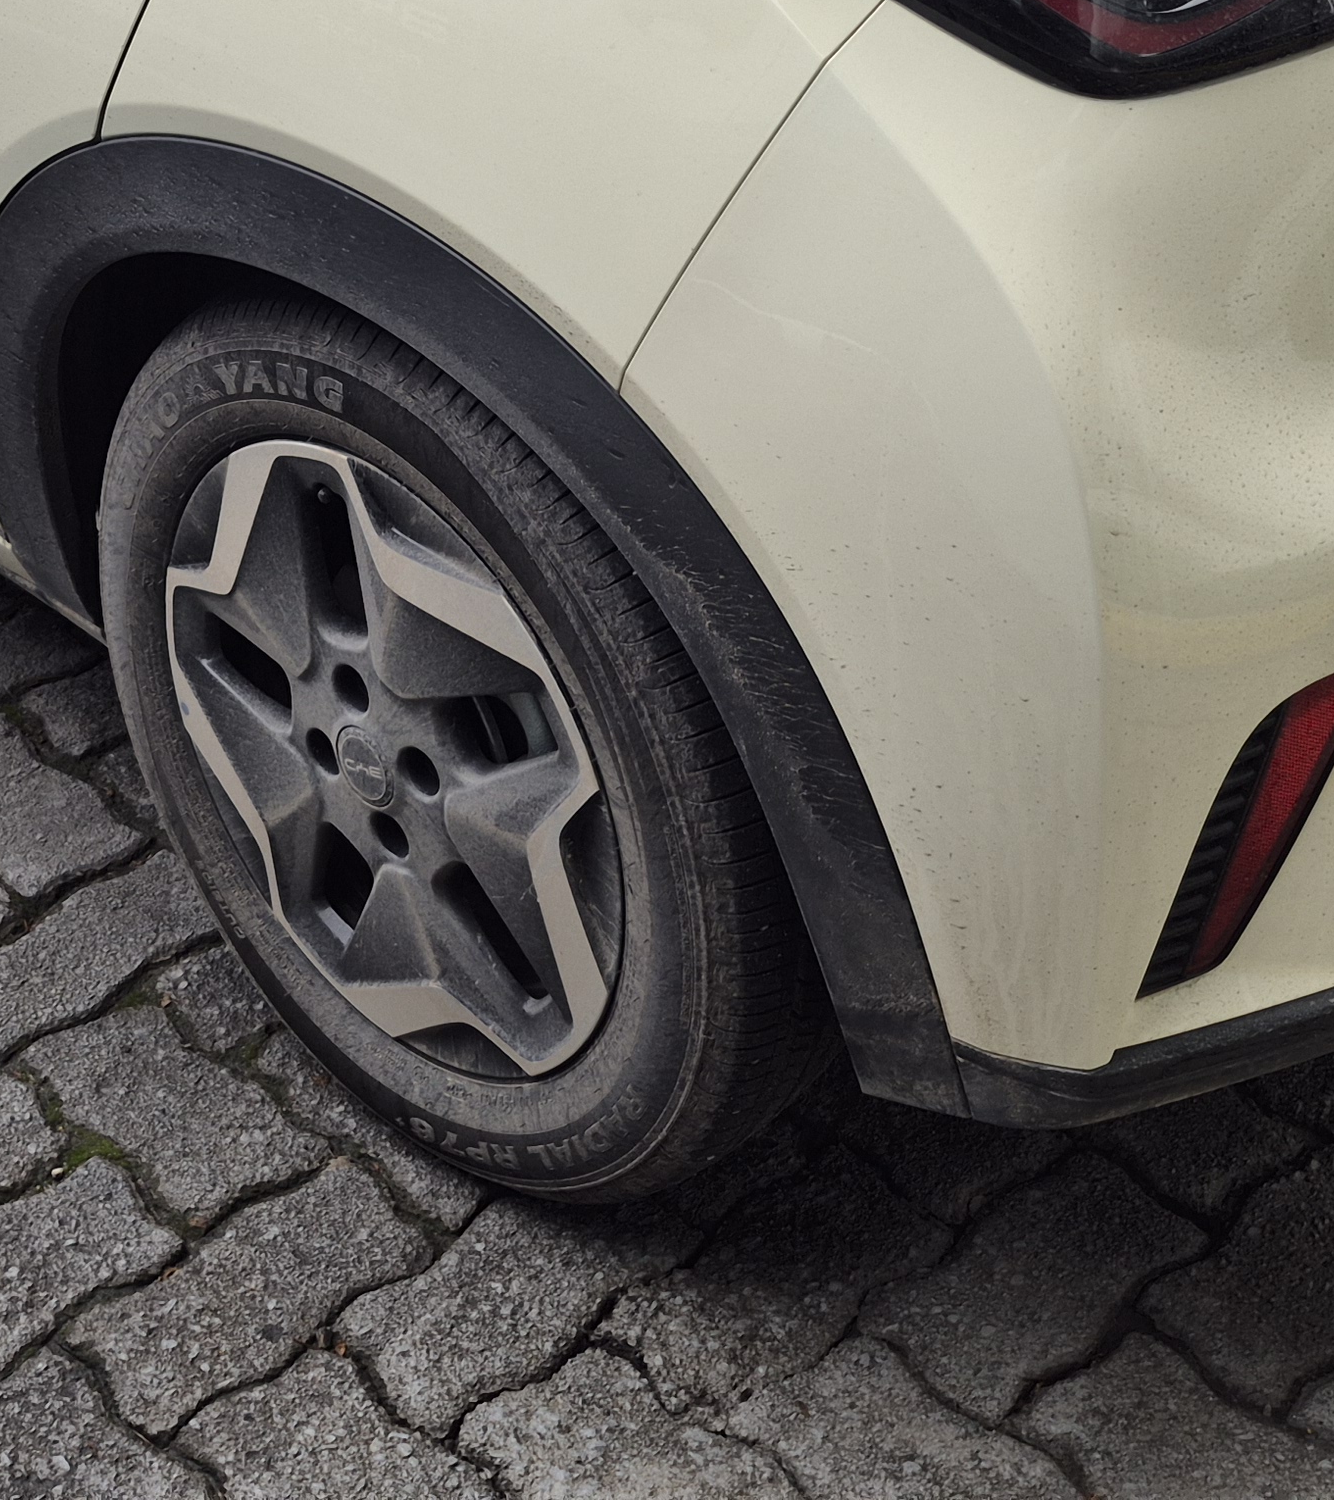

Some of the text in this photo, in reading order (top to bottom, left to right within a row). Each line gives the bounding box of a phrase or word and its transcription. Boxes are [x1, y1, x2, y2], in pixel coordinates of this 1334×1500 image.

[213, 360, 345, 414] YANG
[344, 756, 384, 779] BYD
[526, 1084, 647, 1171] RADIAL
